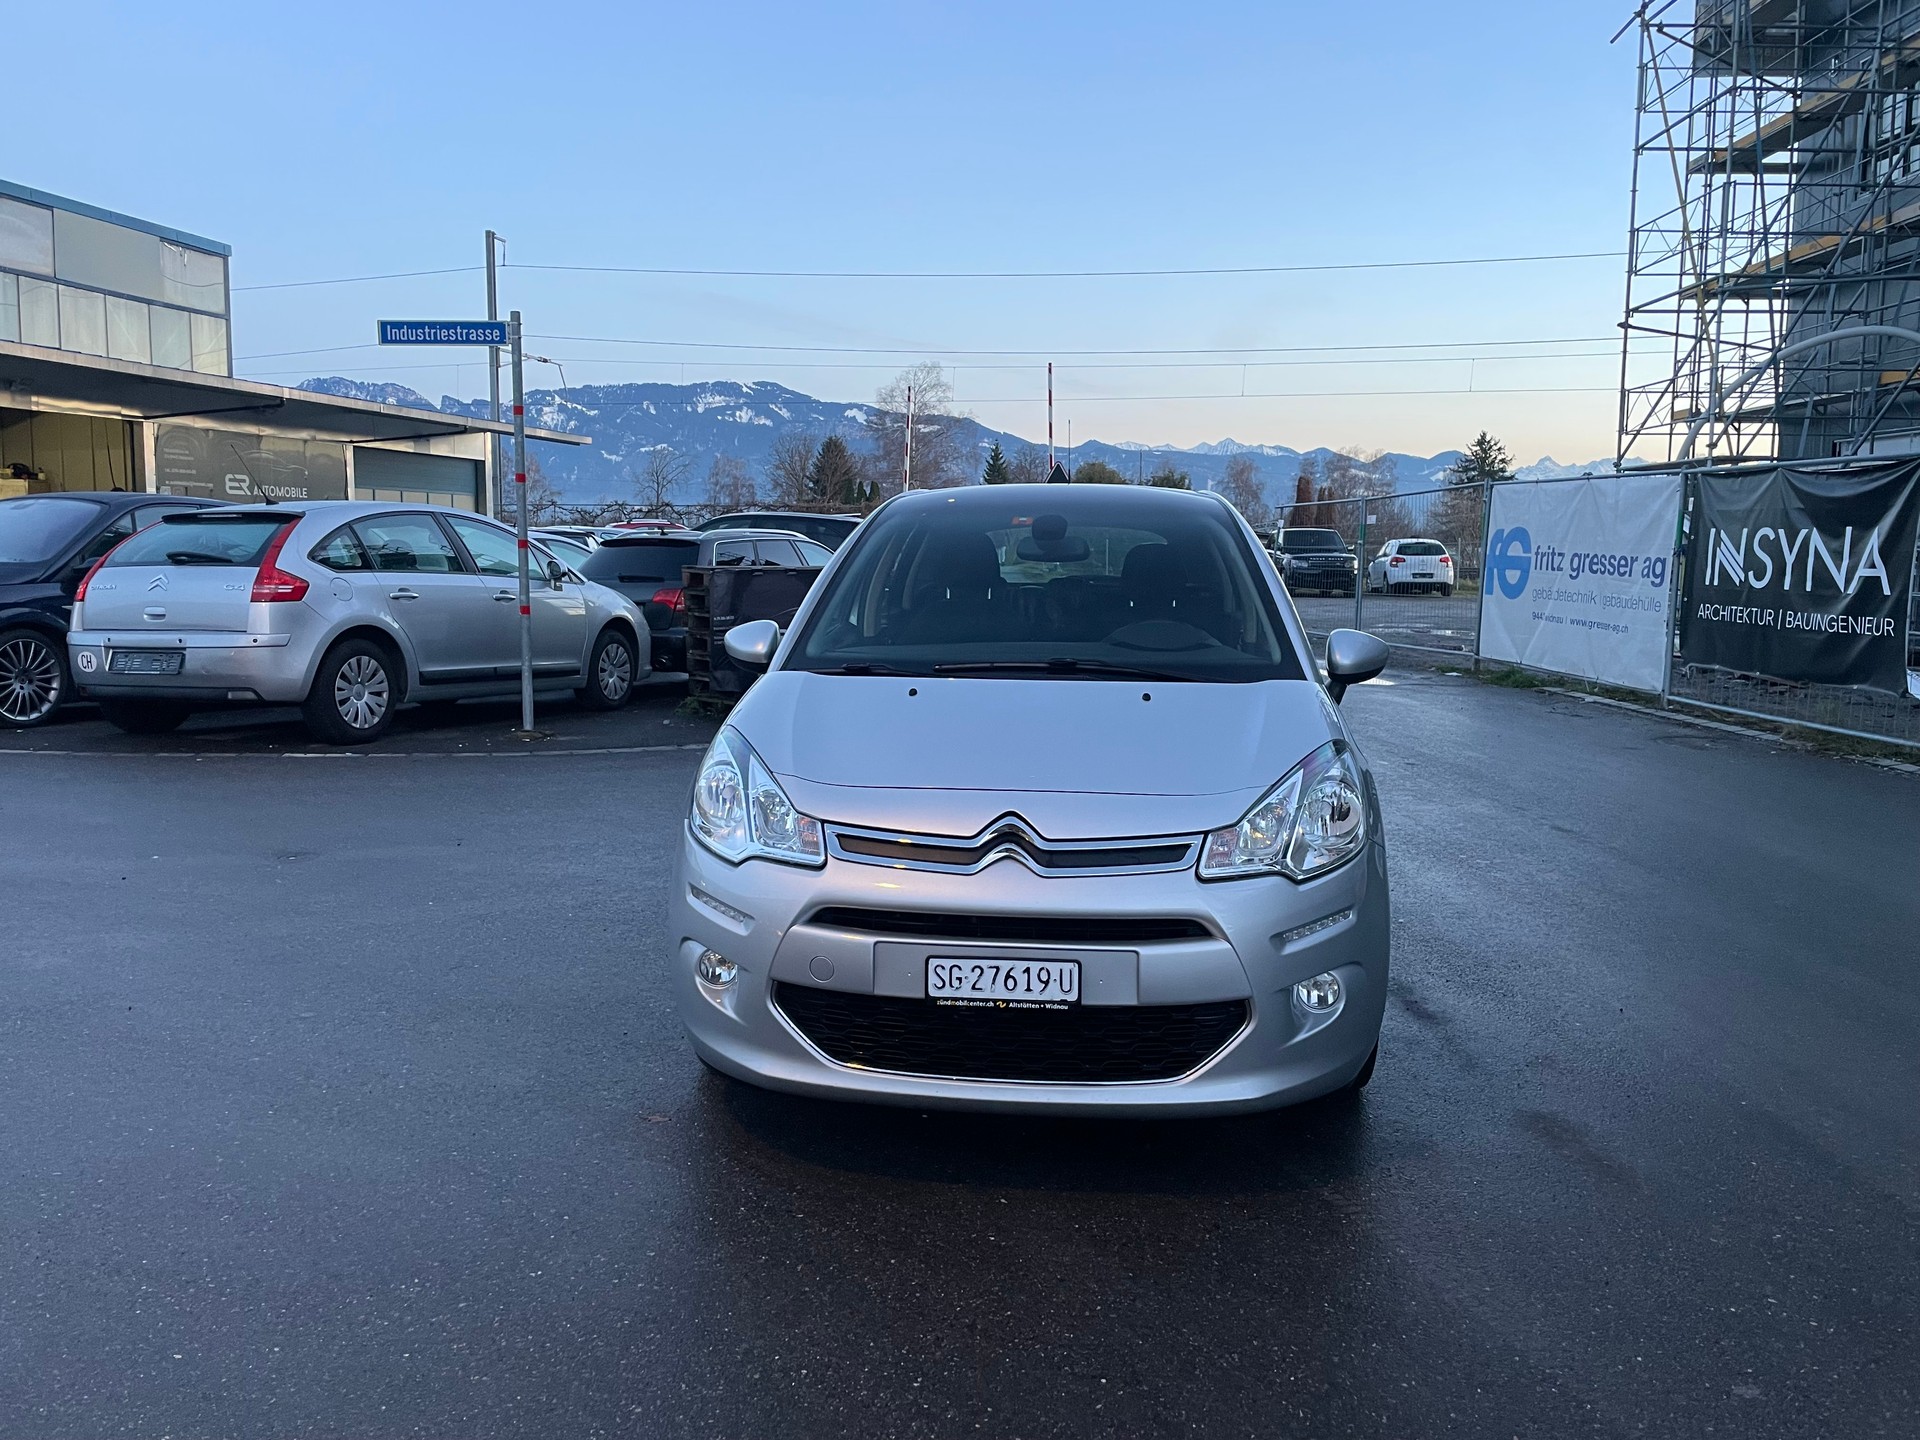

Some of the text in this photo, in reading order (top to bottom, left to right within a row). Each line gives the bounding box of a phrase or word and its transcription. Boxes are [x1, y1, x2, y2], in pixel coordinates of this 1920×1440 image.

[386, 325, 501, 341] Industriestrasse
[253, 485, 308, 499] AUTOMOBILE
[1533, 545, 1668, 588] fritz gresser ag
[1705, 526, 1892, 596] INSYNA
[1531, 587, 1598, 605] gebädetechnik
[1697, 603, 1895, 637] ARCHITEKTUR BAUINGENIEUR
[81, 654, 94, 670] CH
[1008, 1001, 1041, 1009] Altstätten
[1044, 1002, 1069, 1010] Widnau
